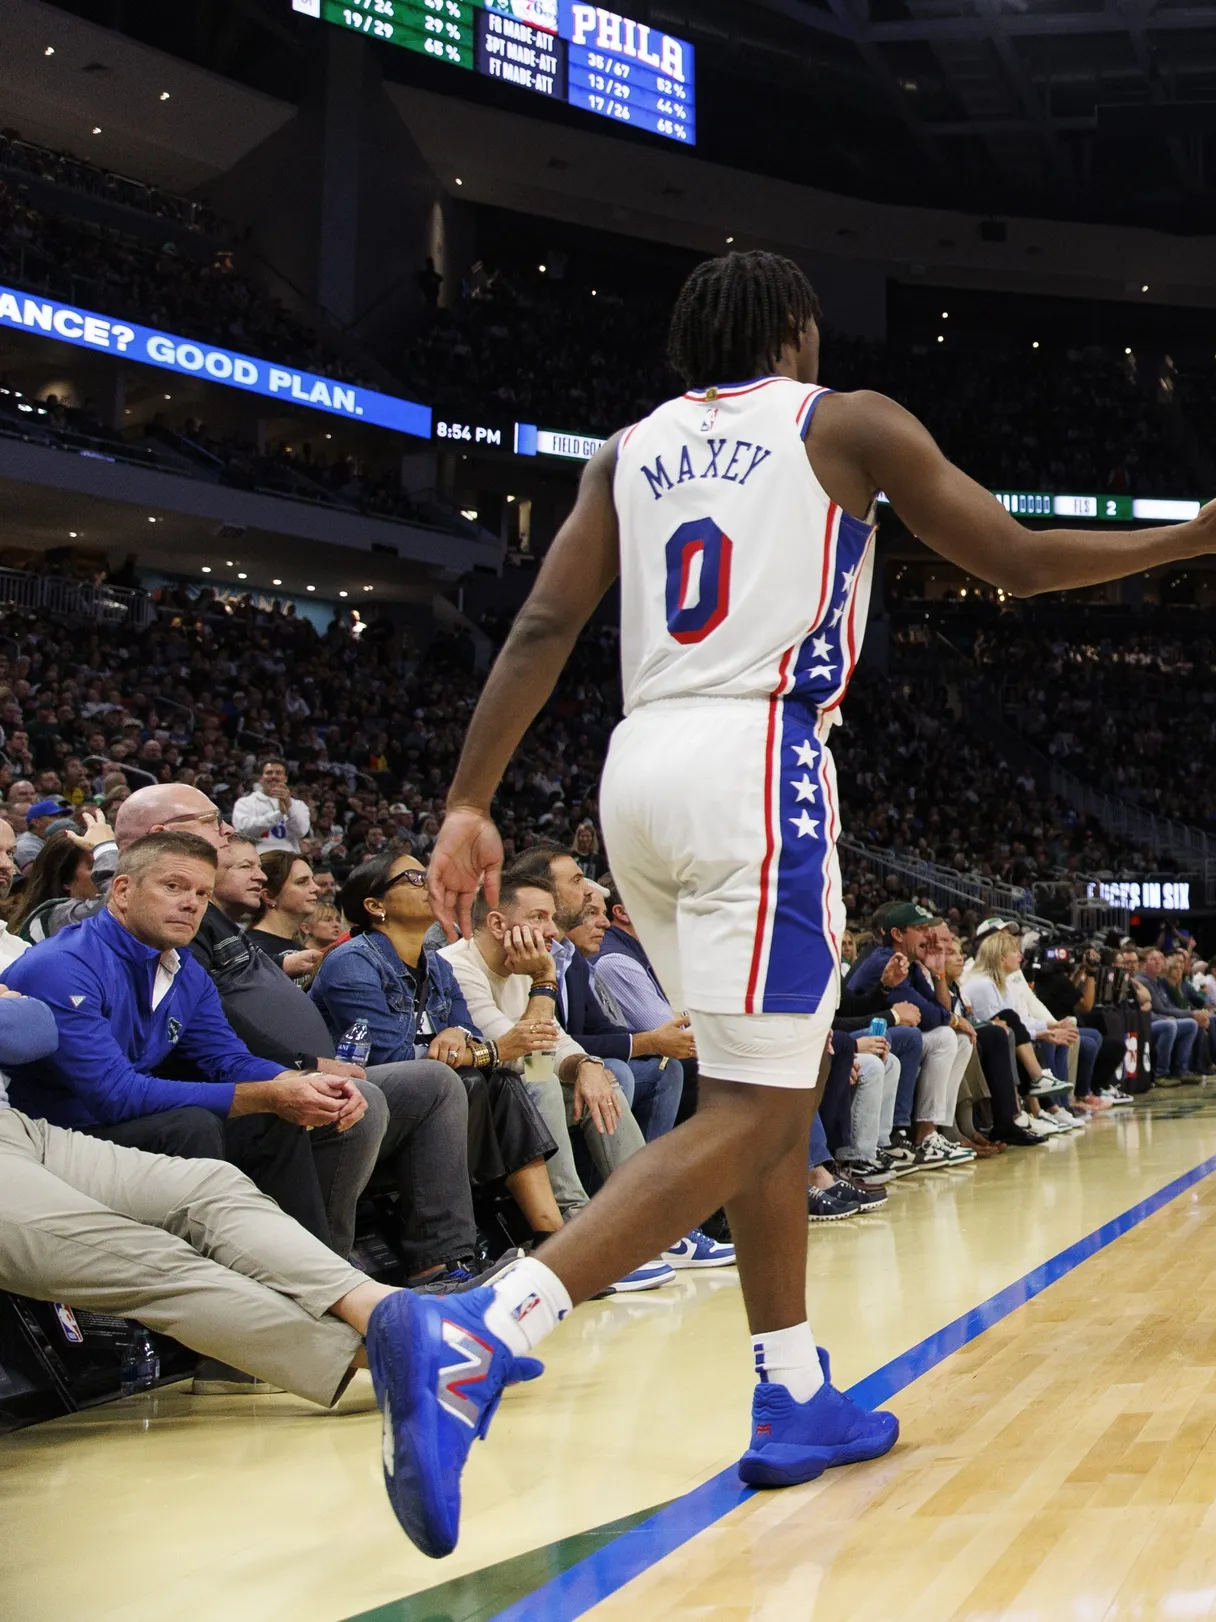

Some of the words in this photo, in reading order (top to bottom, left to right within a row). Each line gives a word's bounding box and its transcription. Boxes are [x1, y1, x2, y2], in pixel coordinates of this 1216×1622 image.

[503, 17, 555, 53] MADE-ATT
[572, 4, 686, 83] PHILA
[485, 34, 506, 56] 3PT
[506, 37, 557, 75] MADE-ATT
[489, 57, 502, 76] FT
[502, 60, 554, 94] MADE-ATT
[146, 335, 259, 387] GOOD
[269, 368, 364, 415] PLAN.
[436, 421, 472, 442] 8:54
[475, 427, 501, 446] PM
[553, 436, 580, 455] FIELD
[640, 438, 772, 500] MAXEY
[1106, 500, 1117, 516] 2
[665, 516, 734, 645] 0
[1142, 882, 1162, 909] IN
[1162, 882, 1190, 911] SIX
